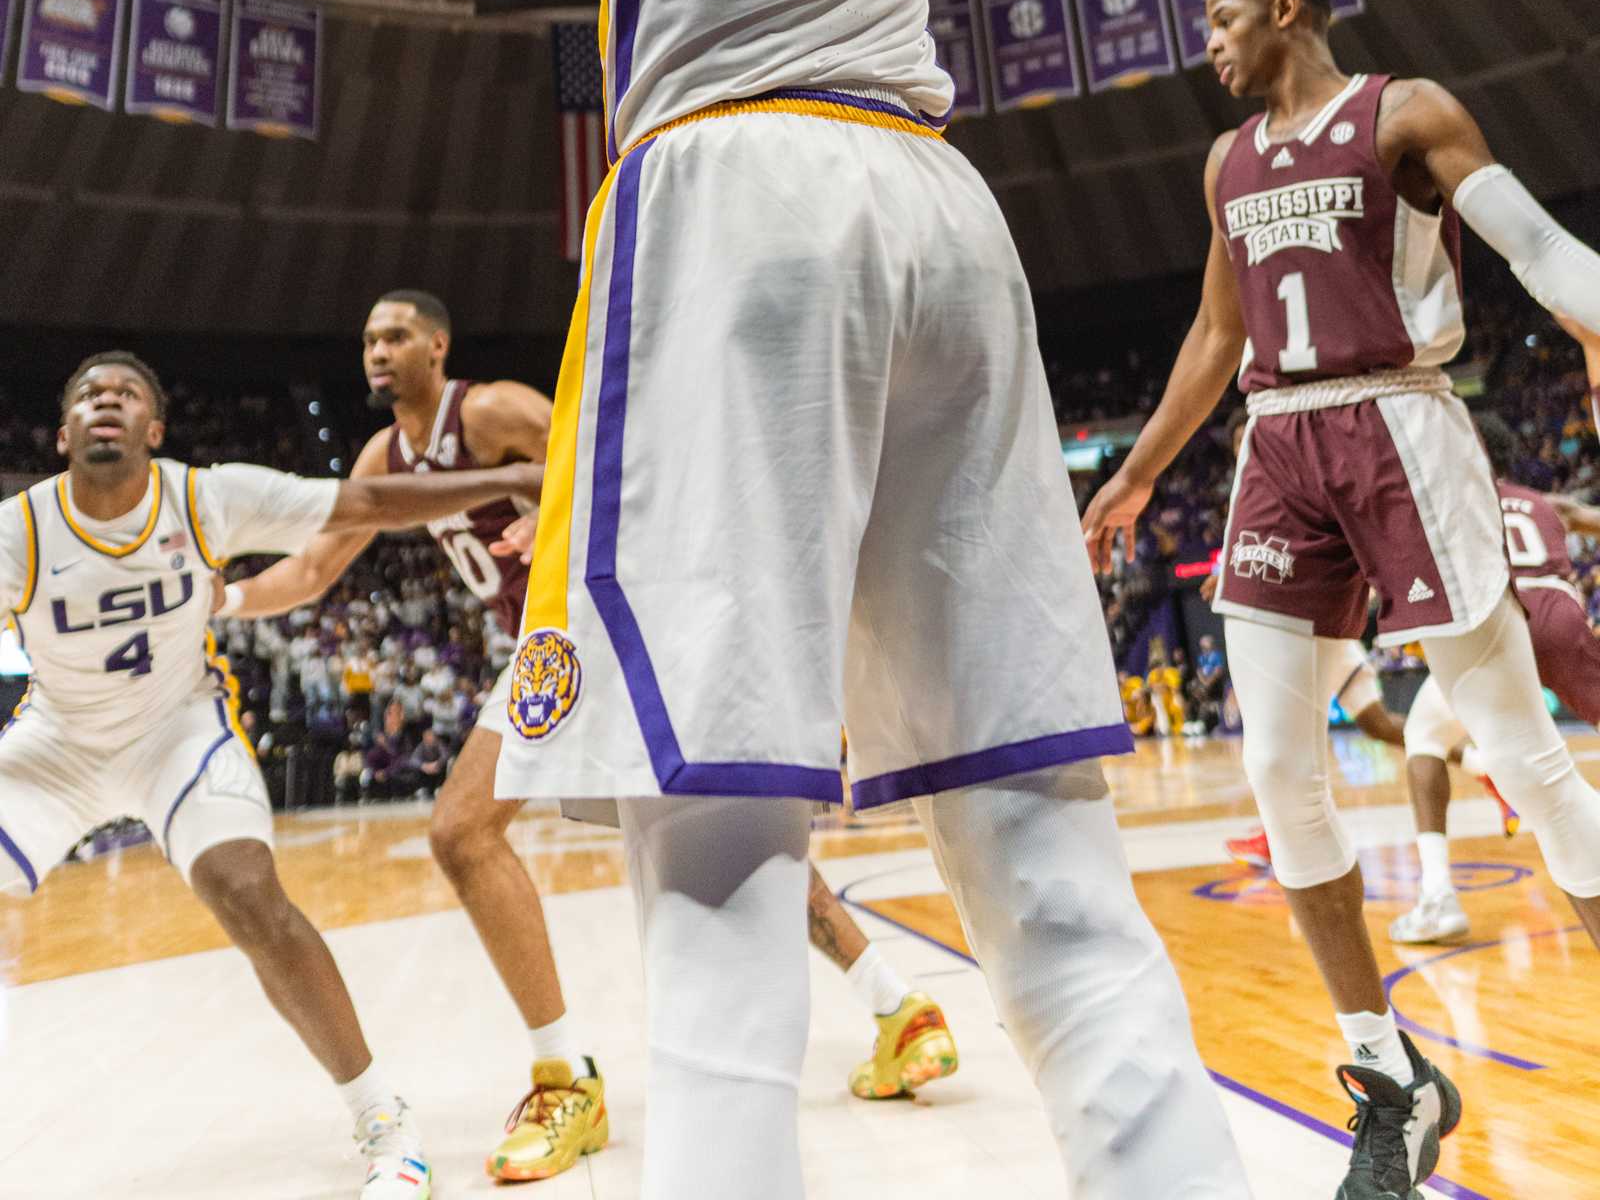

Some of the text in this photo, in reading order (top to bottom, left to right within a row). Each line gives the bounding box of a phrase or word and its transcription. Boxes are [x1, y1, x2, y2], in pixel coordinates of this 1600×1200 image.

[1226, 183, 1364, 233] MISSISSIPPI
[1258, 221, 1321, 250] STATE
[1277, 271, 1318, 372] 1
[1240, 548, 1280, 566] STATE
[52, 572, 193, 634] LSU
[105, 629, 153, 677] 4
